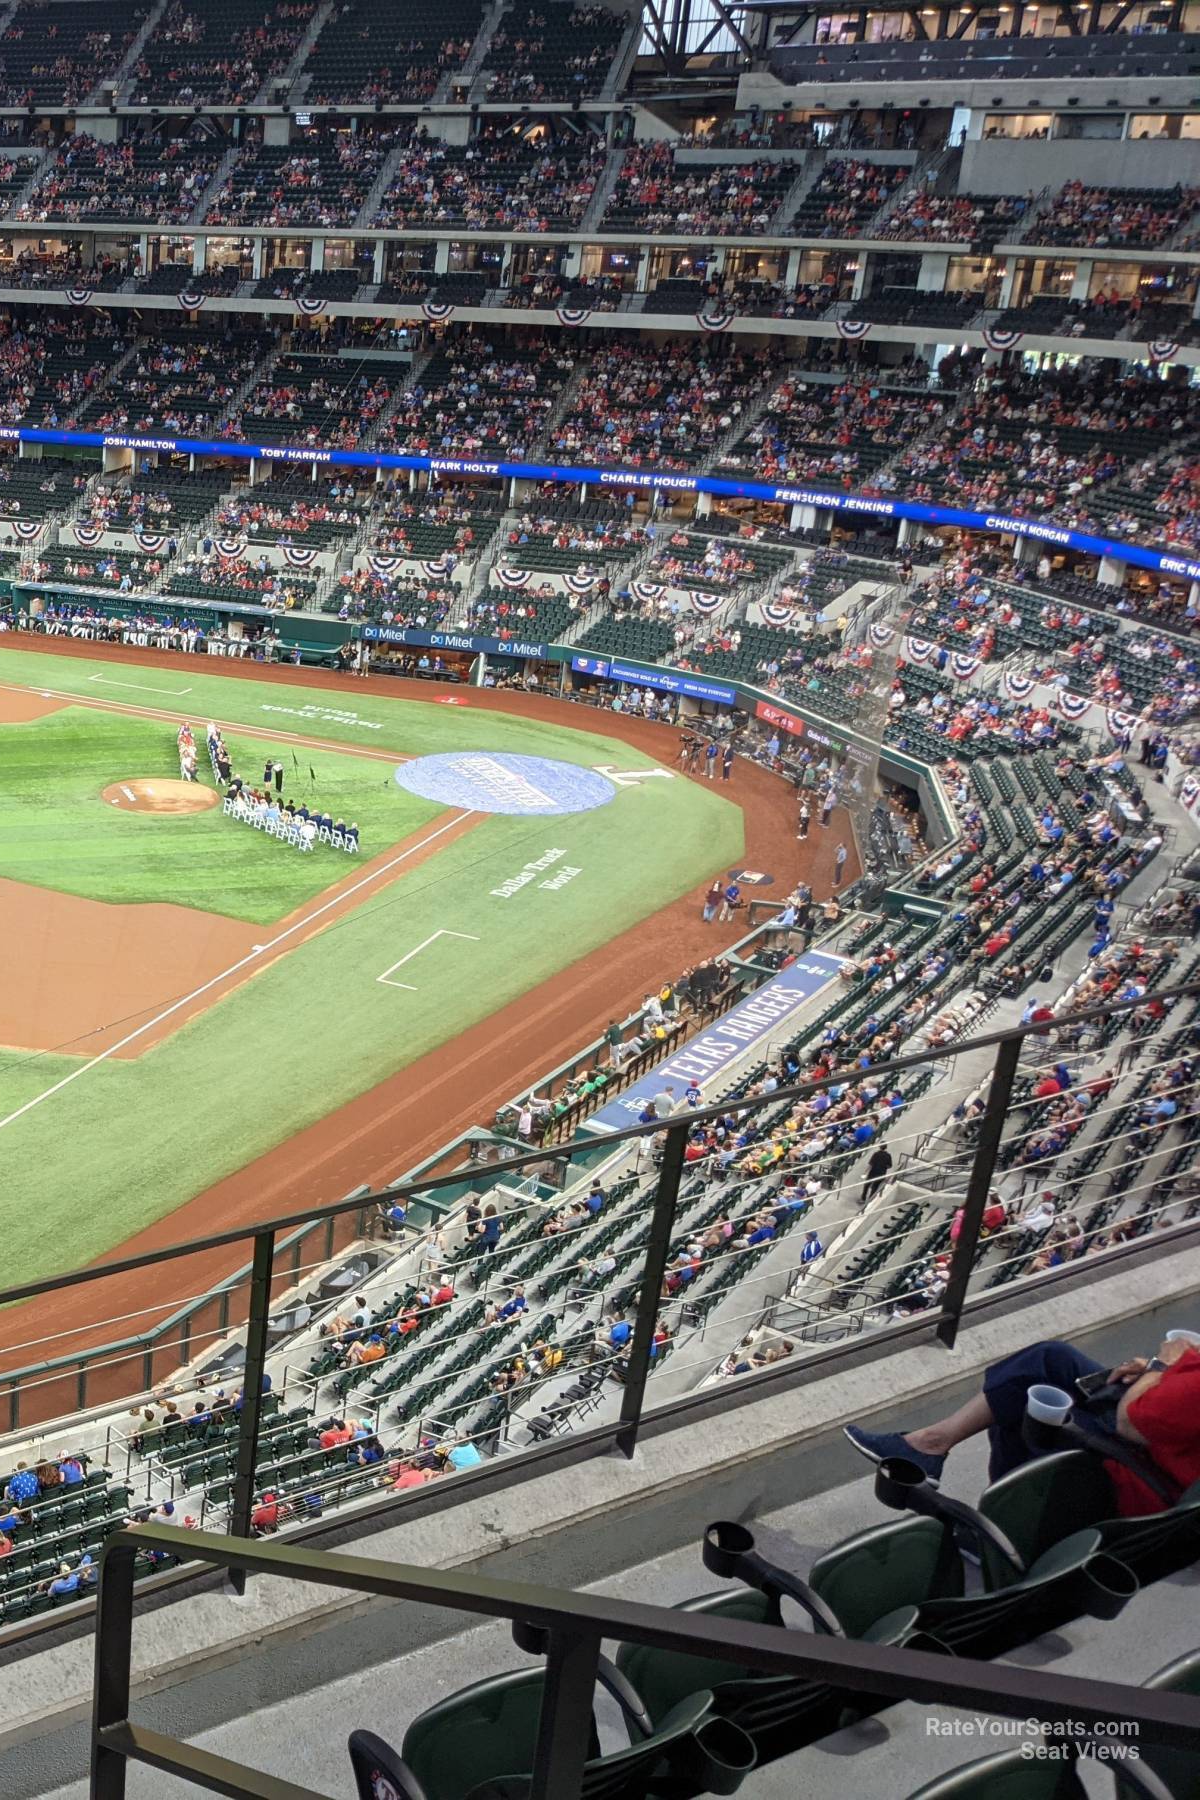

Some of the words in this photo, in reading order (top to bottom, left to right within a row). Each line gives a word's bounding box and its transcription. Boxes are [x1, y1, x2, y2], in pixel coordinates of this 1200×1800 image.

[102, 437, 126, 446] JOSH
[128, 439, 176, 450] HAMILTON
[260, 448, 286, 458] TOBY
[288, 450, 330, 461] HARRAH
[430, 460, 461, 472] MARK
[464, 462, 498, 474] HOLTZ
[600, 473, 651, 485] CHARLIE
[654, 476, 696, 488] HOUGH
[775, 490, 840, 506] FERGUSON
[841, 499, 894, 514] JENKINS
[985, 518, 1027, 533] CHUCK
[1028, 525, 1070, 543] MORGAN
[1159, 558, 1185, 574] ERIC
[379, 628, 406, 641] Mitel
[445, 636, 474, 648] Mitel
[512, 644, 542, 656] Mitel
[488, 871, 537, 898] Dallas
[522, 847, 568, 871] Truck
[537, 865, 584, 890] World
[658, 1036, 739, 1082] TEXAS
[715, 984, 806, 1041] RANGERS
